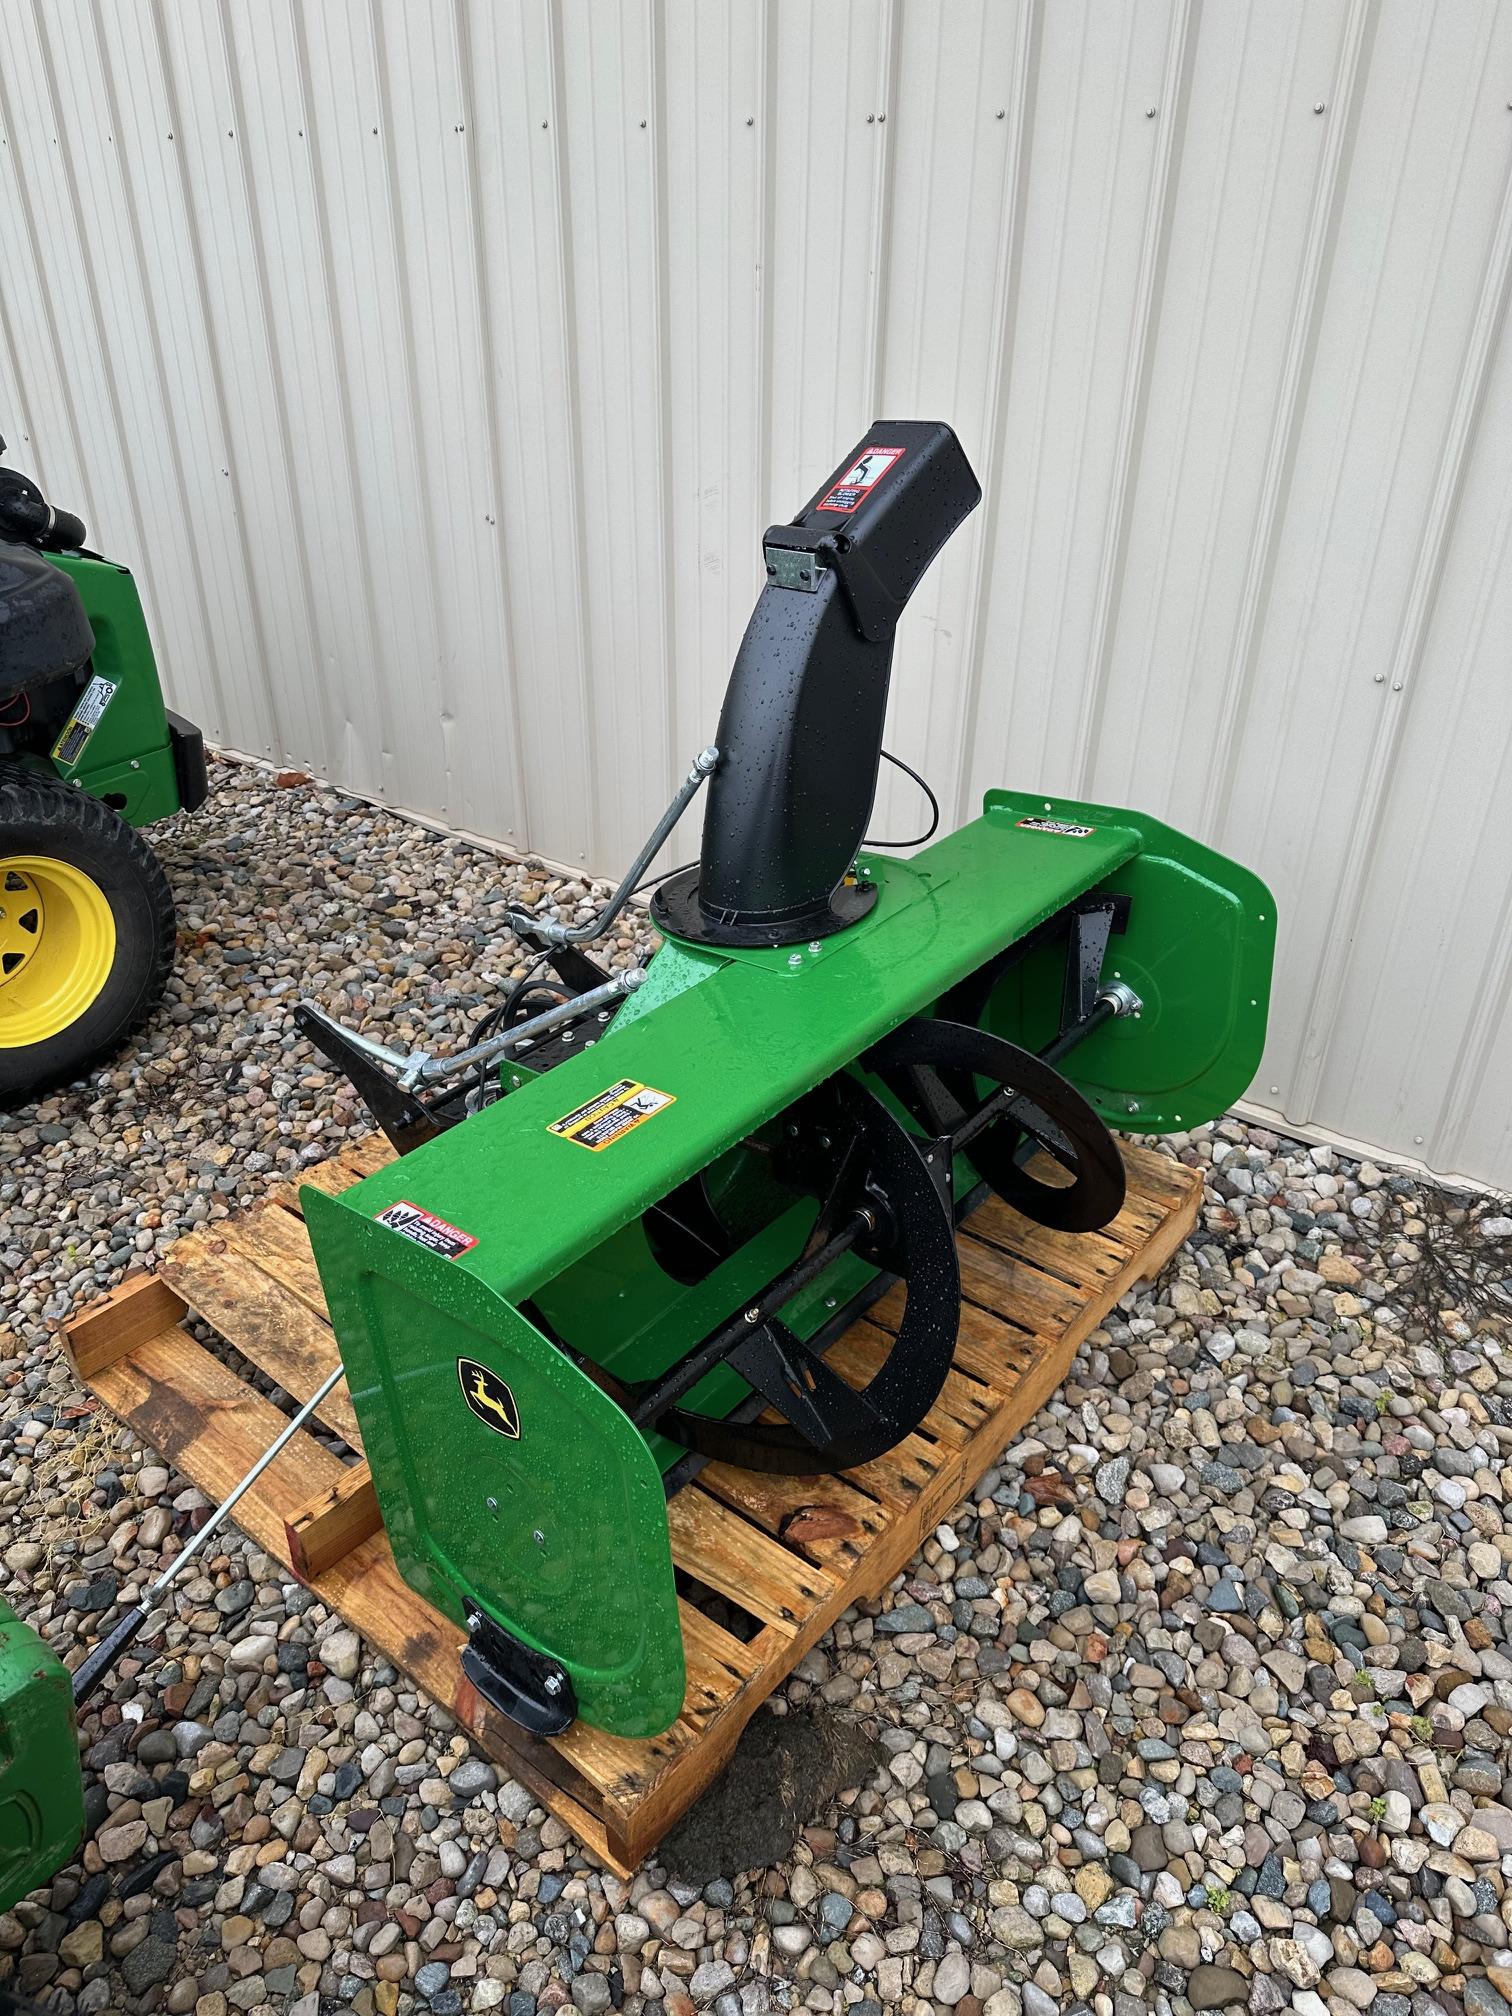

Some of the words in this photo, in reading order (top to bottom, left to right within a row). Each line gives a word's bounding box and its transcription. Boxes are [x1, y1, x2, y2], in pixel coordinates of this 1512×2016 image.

[584, 1102, 614, 1122] CAUTION
[603, 1122, 635, 1144] WARNING
[430, 1220, 472, 1245] DANGER
